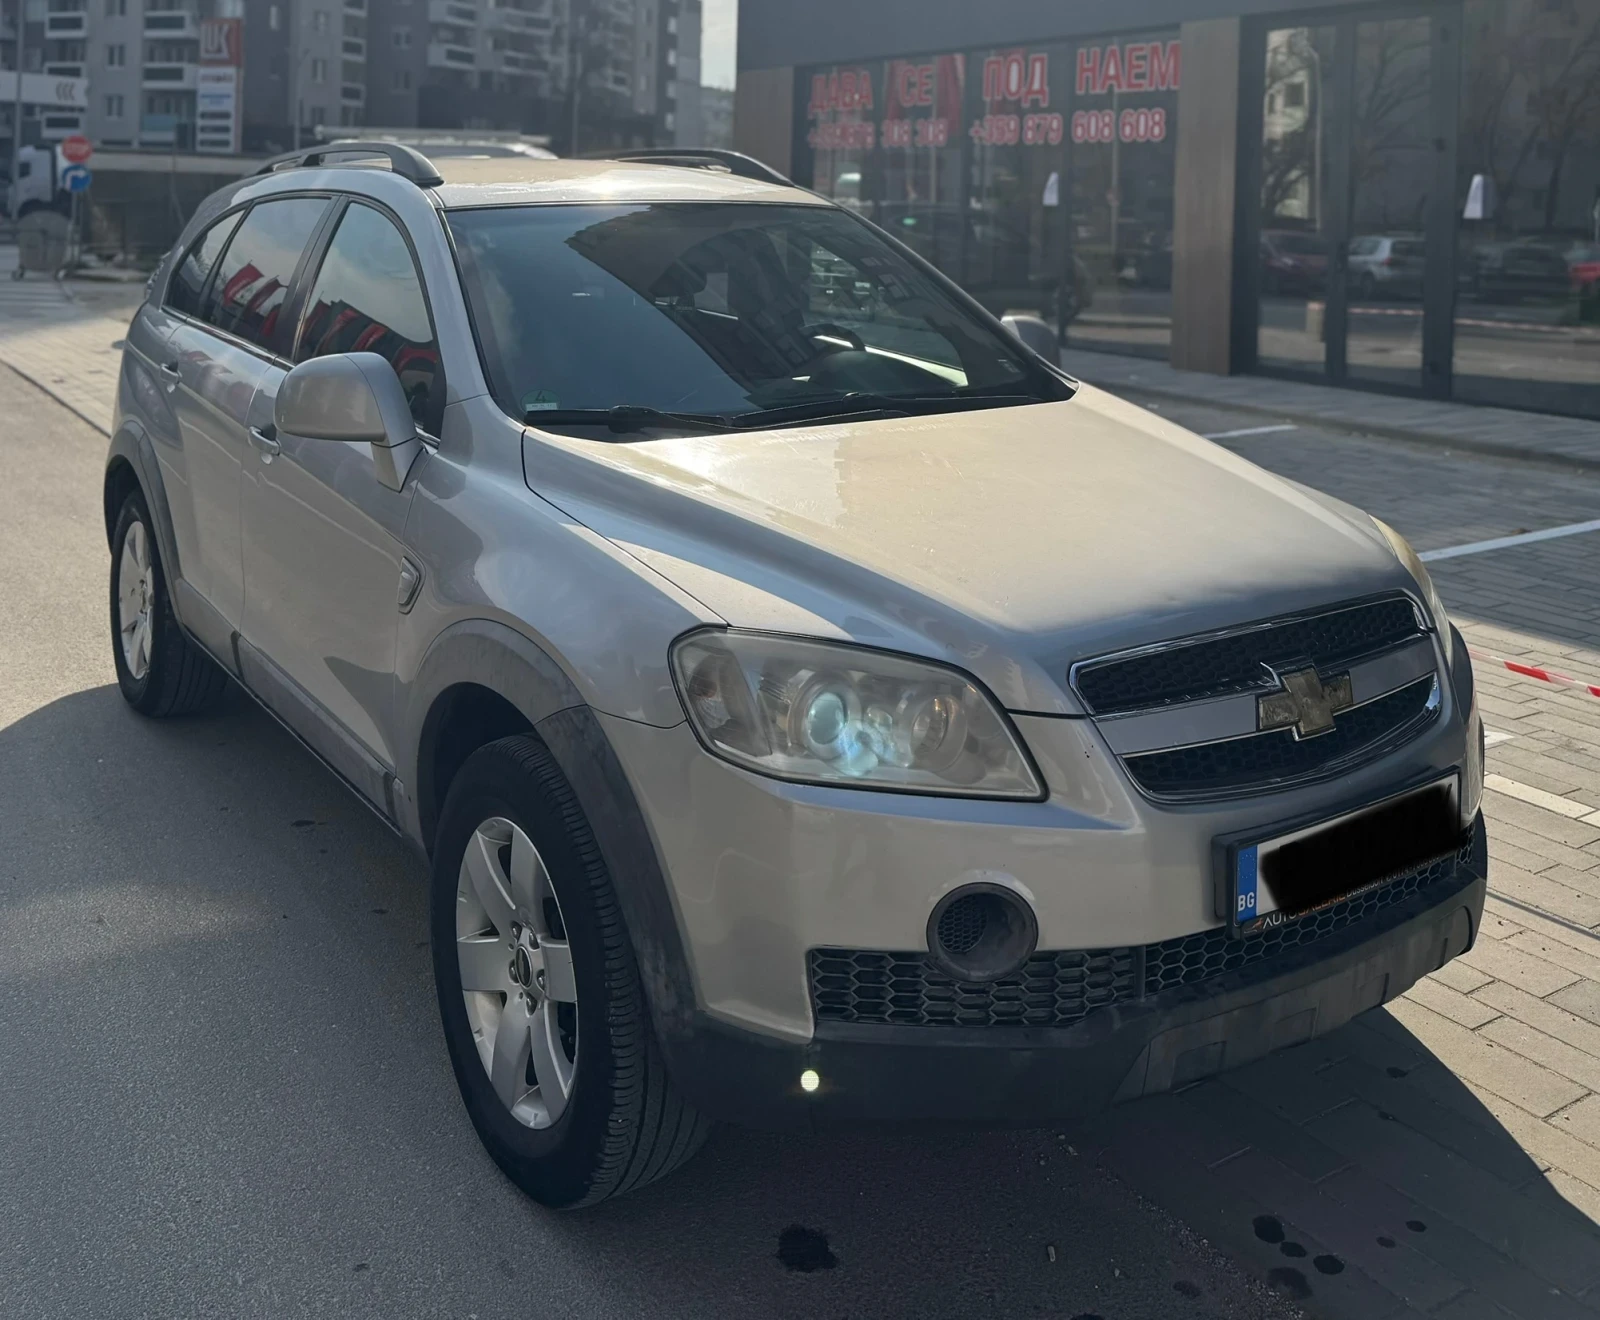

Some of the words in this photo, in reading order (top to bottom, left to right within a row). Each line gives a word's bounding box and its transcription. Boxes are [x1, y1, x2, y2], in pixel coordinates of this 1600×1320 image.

[808, 70, 874, 118] ДАВА
[900, 64, 934, 107] СЕ
[983, 53, 1049, 107] ПОД
[1076, 42, 1180, 94] НАЕМ
[1023, 113, 1063, 145] 879
[1072, 110, 1115, 143] 608
[1120, 108, 1165, 142] 608
[1238, 892, 1255, 912] BG
